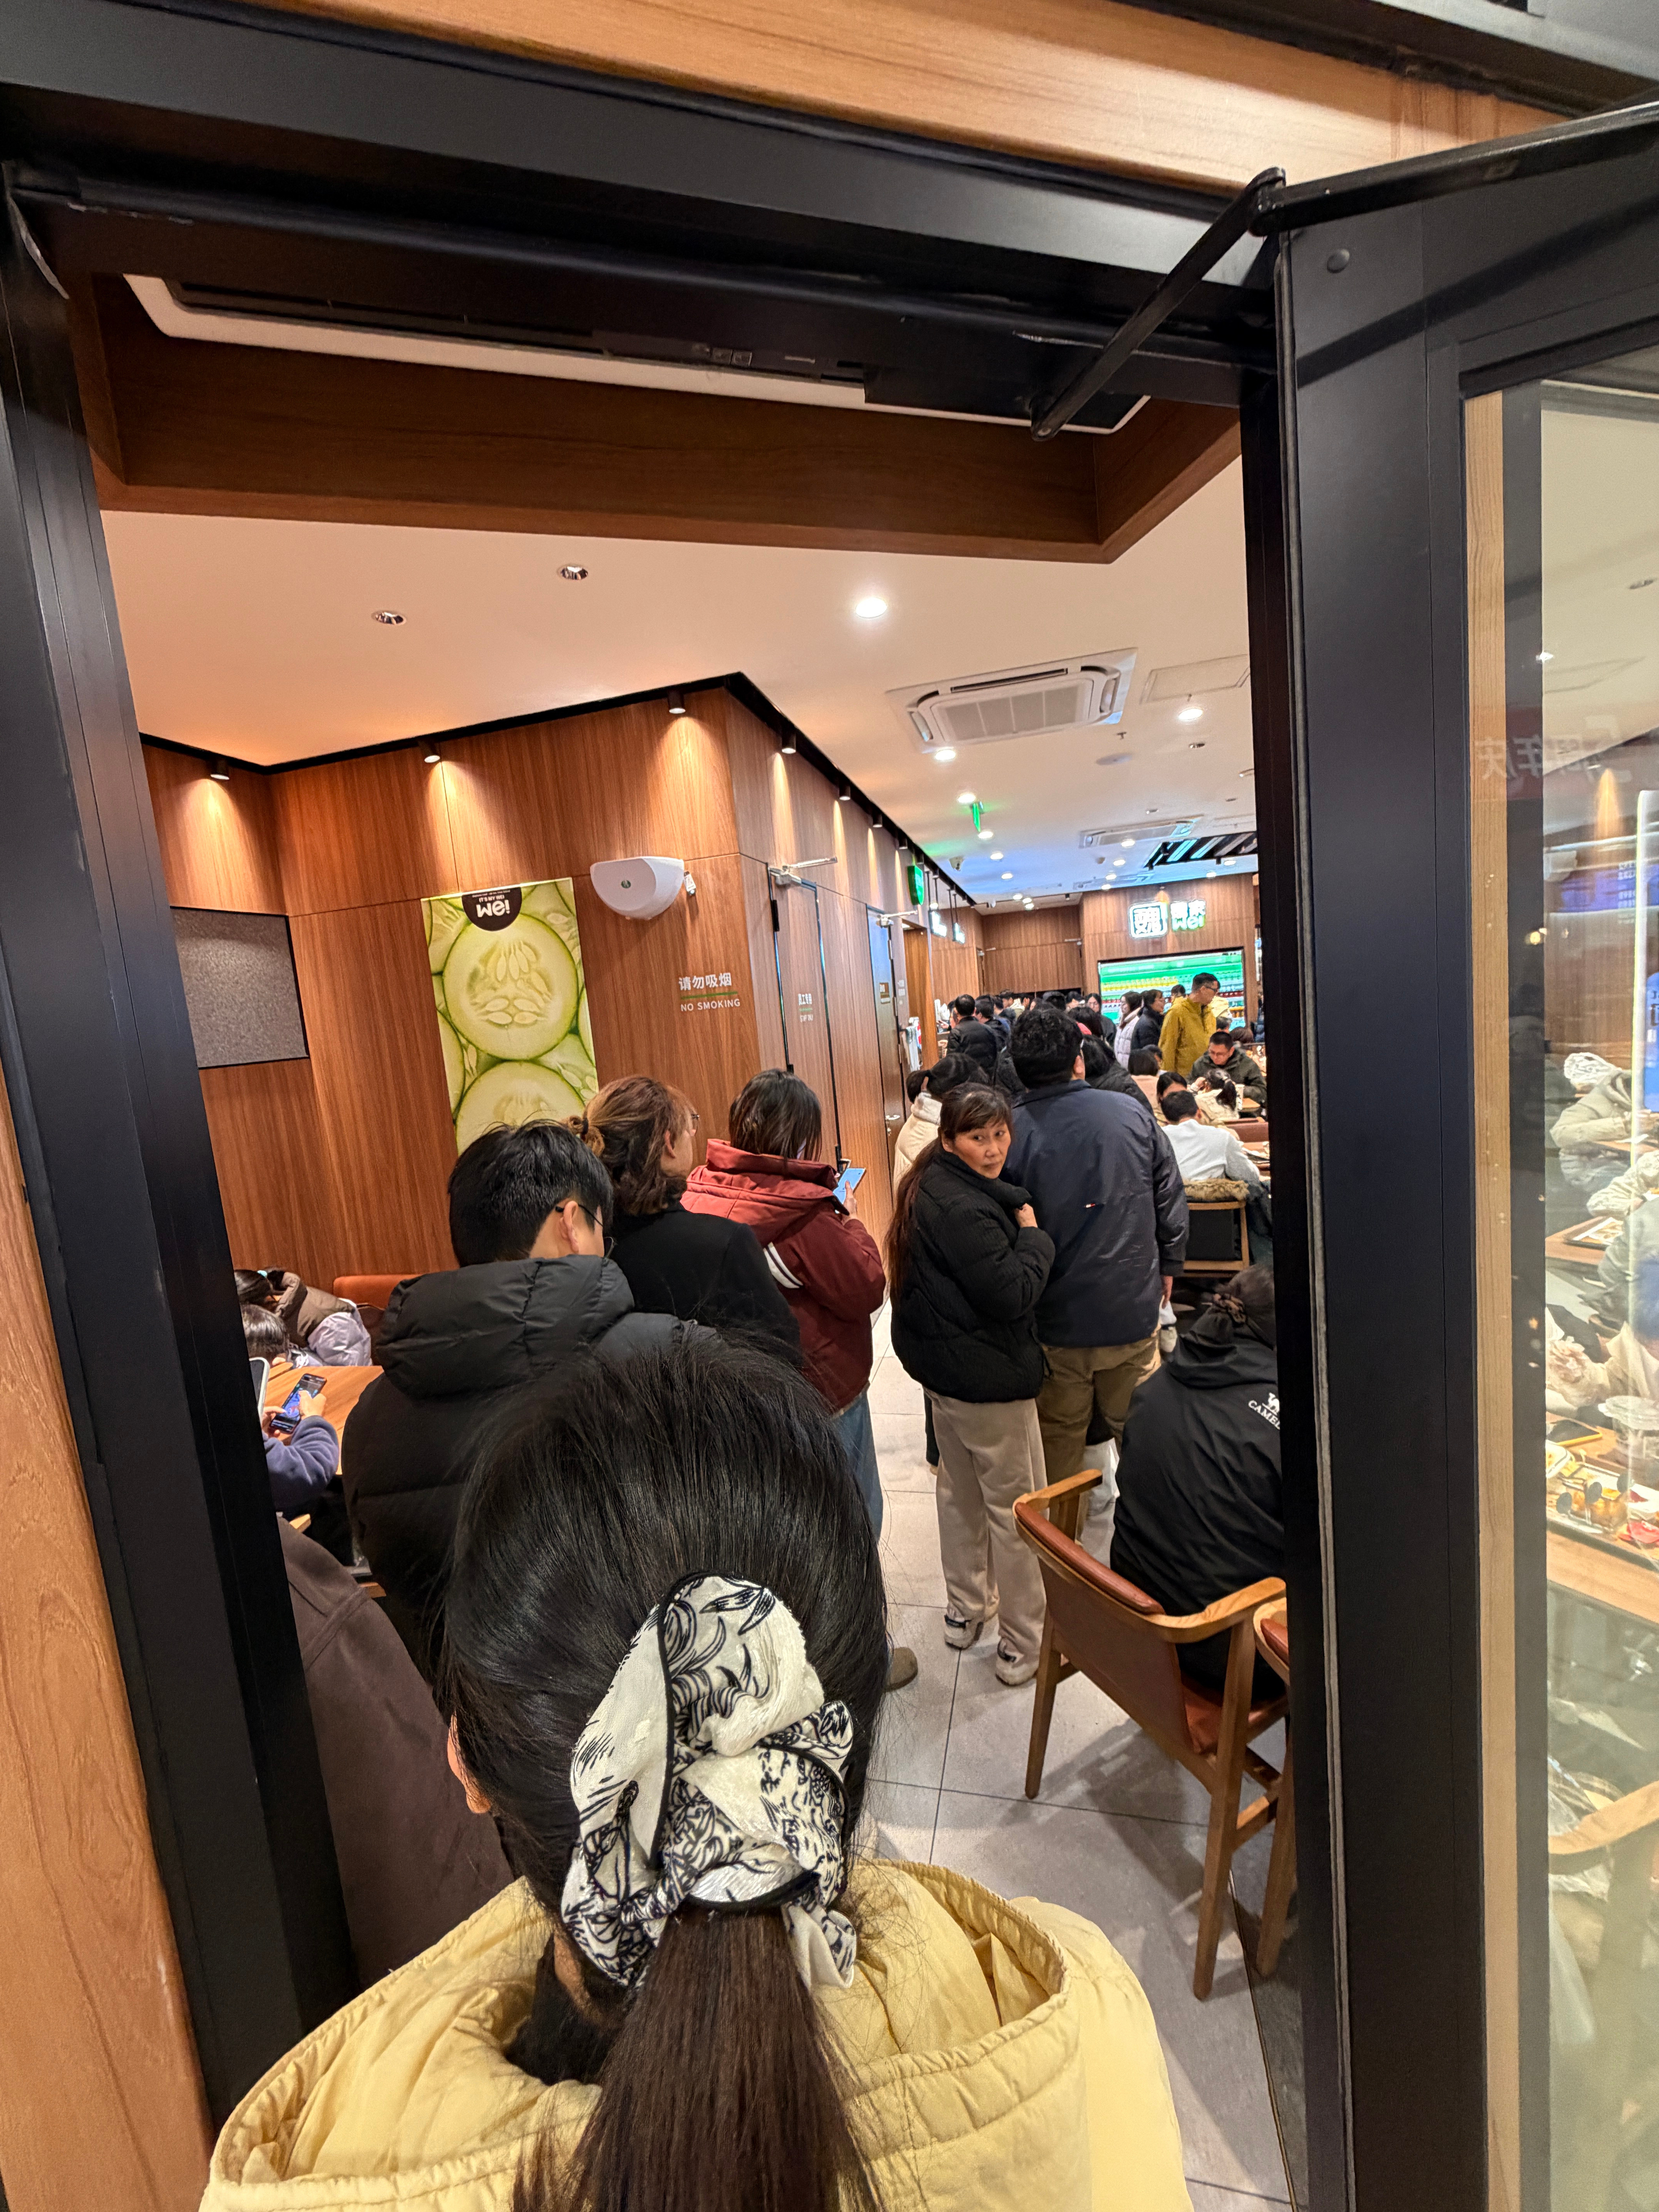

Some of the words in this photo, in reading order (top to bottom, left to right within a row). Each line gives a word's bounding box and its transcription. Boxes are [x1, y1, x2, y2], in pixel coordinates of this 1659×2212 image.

[678, 973, 732, 991] 请勿吸烟
[680, 1003, 694, 1012] NO
[697, 999, 740, 1010] SMOKING
[1248, 1400, 1280, 1430] CAMEL
